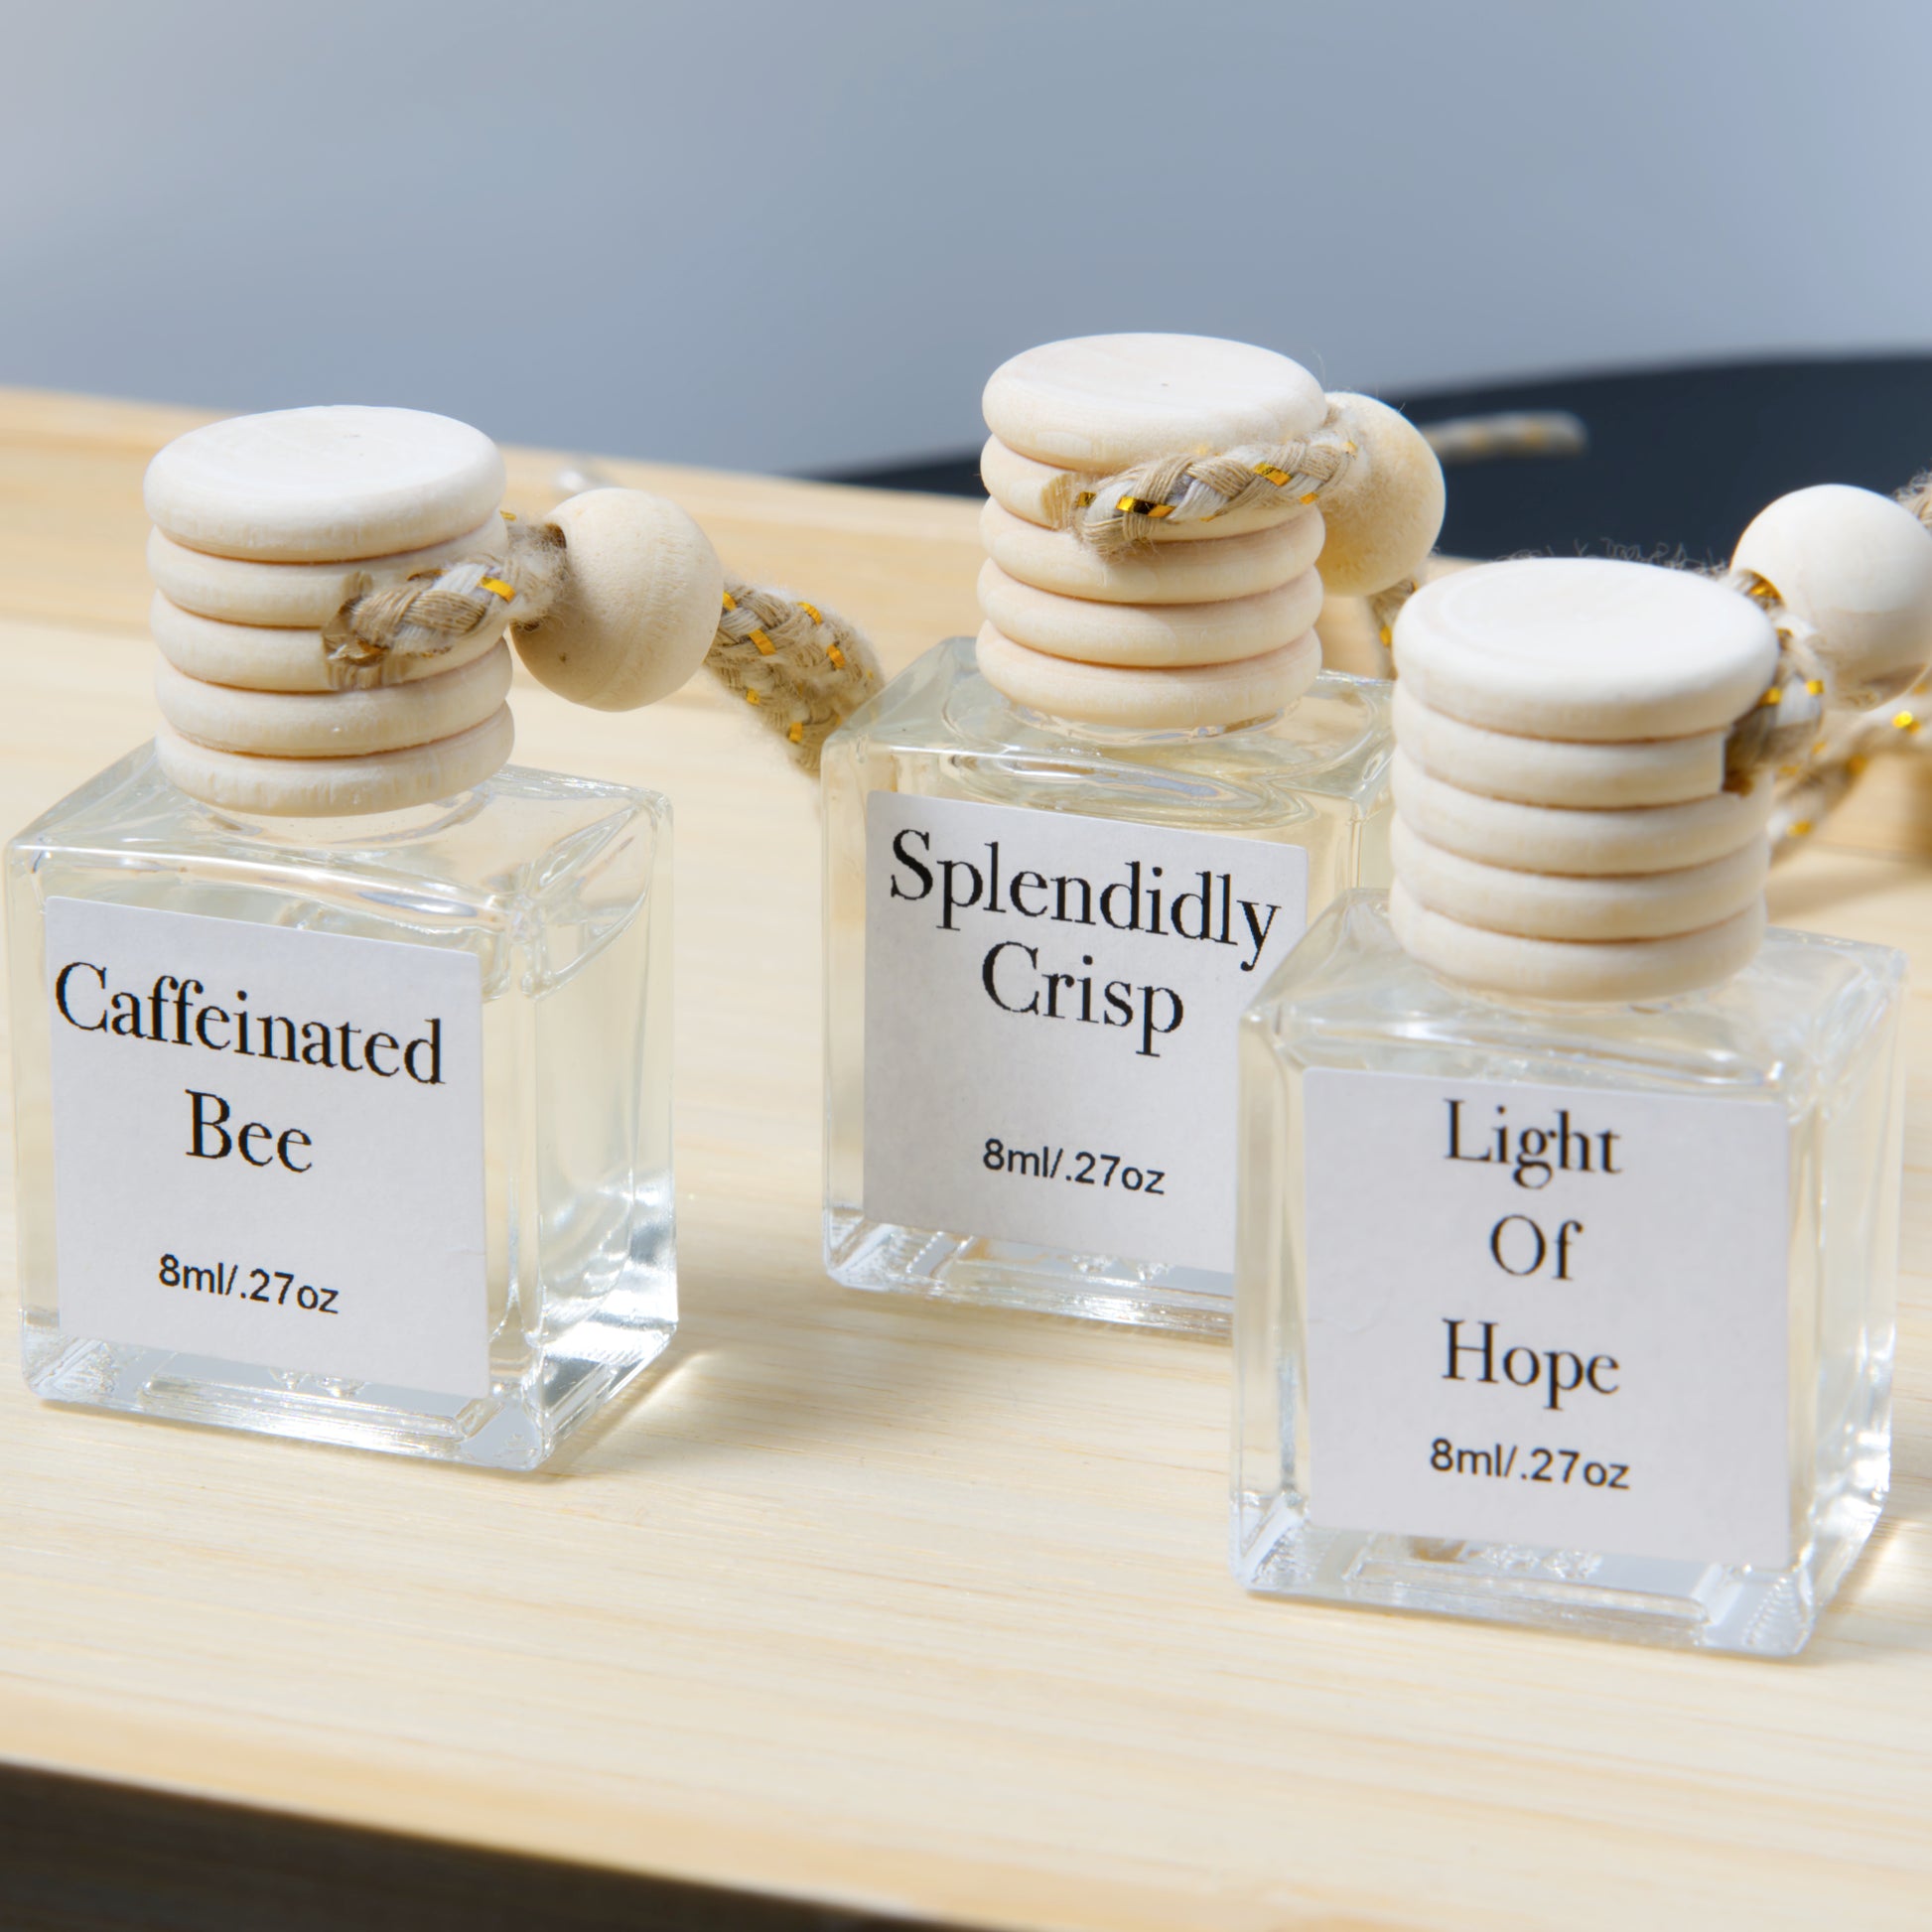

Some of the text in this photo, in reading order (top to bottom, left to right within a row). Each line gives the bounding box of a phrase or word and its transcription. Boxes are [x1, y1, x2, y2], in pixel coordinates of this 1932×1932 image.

[890, 828, 1282, 972] Splendidly
[56, 960, 446, 1086] Caffeinated
[981, 940, 1184, 1057] Crisp
[184, 1088, 314, 1173] Bee
[982, 1138, 1166, 1196] 8ml/.27oz
[1443, 1097, 1623, 1189] Light
[159, 1253, 340, 1315] 8ml/.27oz
[1489, 1214, 1584, 1281] Of
[1441, 1318, 1621, 1411] Hope
[1431, 1438, 1629, 1490] 8ml/.27oz
